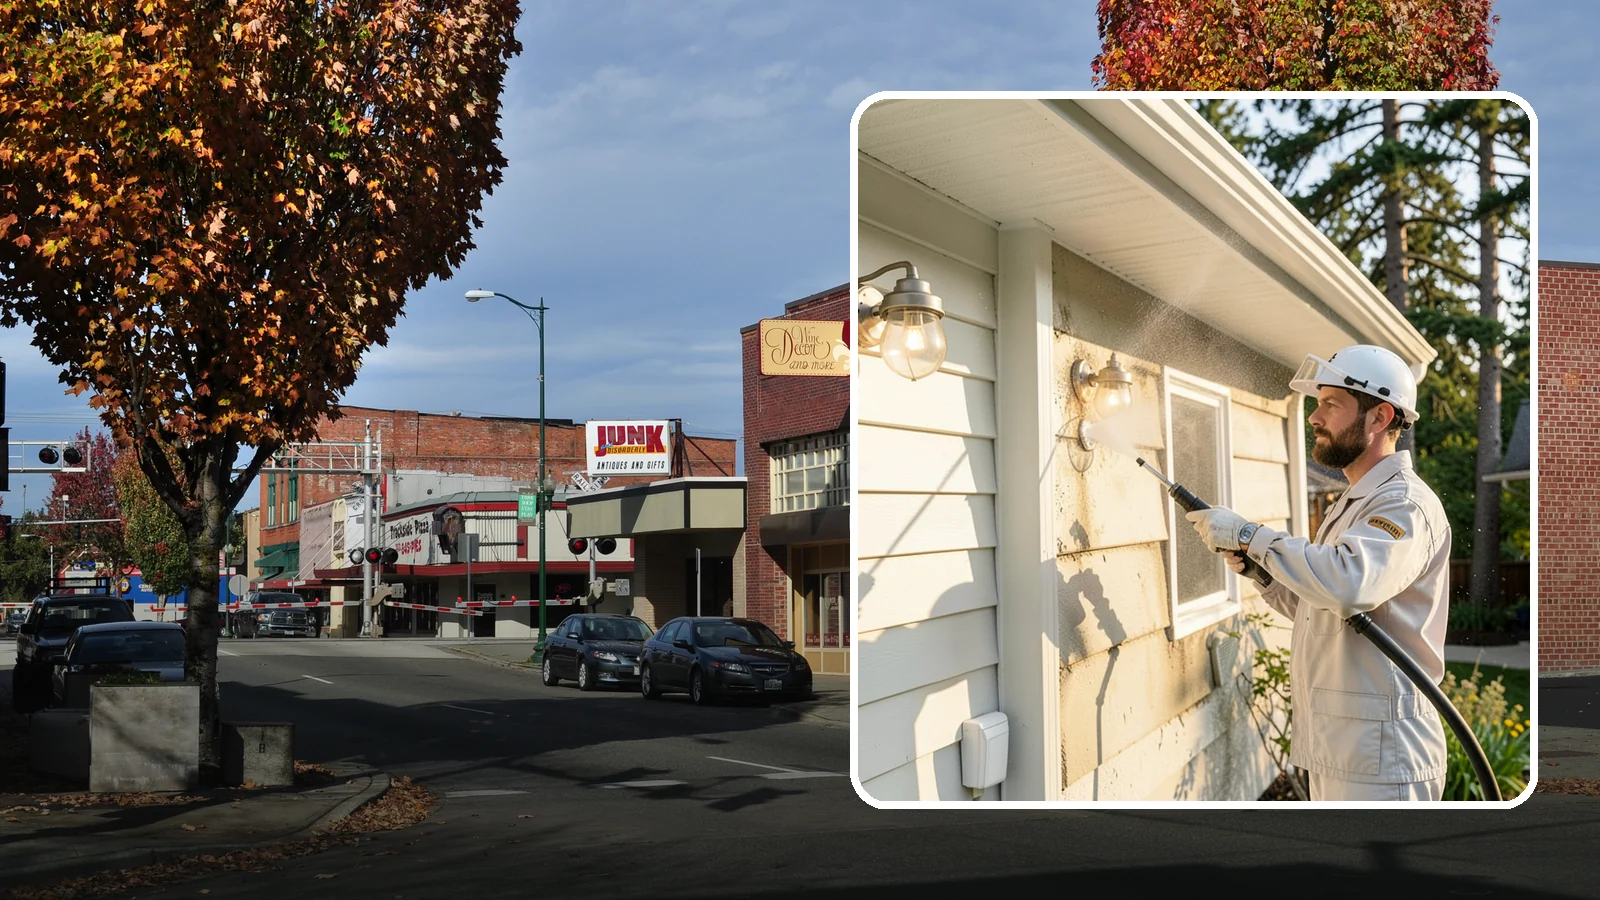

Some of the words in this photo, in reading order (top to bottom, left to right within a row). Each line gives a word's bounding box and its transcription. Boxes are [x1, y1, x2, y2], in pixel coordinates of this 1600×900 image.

[595, 425, 665, 457] JUNK
[607, 446, 646, 454] DISORDERLY
[597, 461, 628, 470] ANTIQUES
[631, 461, 643, 470] AND
[647, 460, 665, 469] GIFTS
